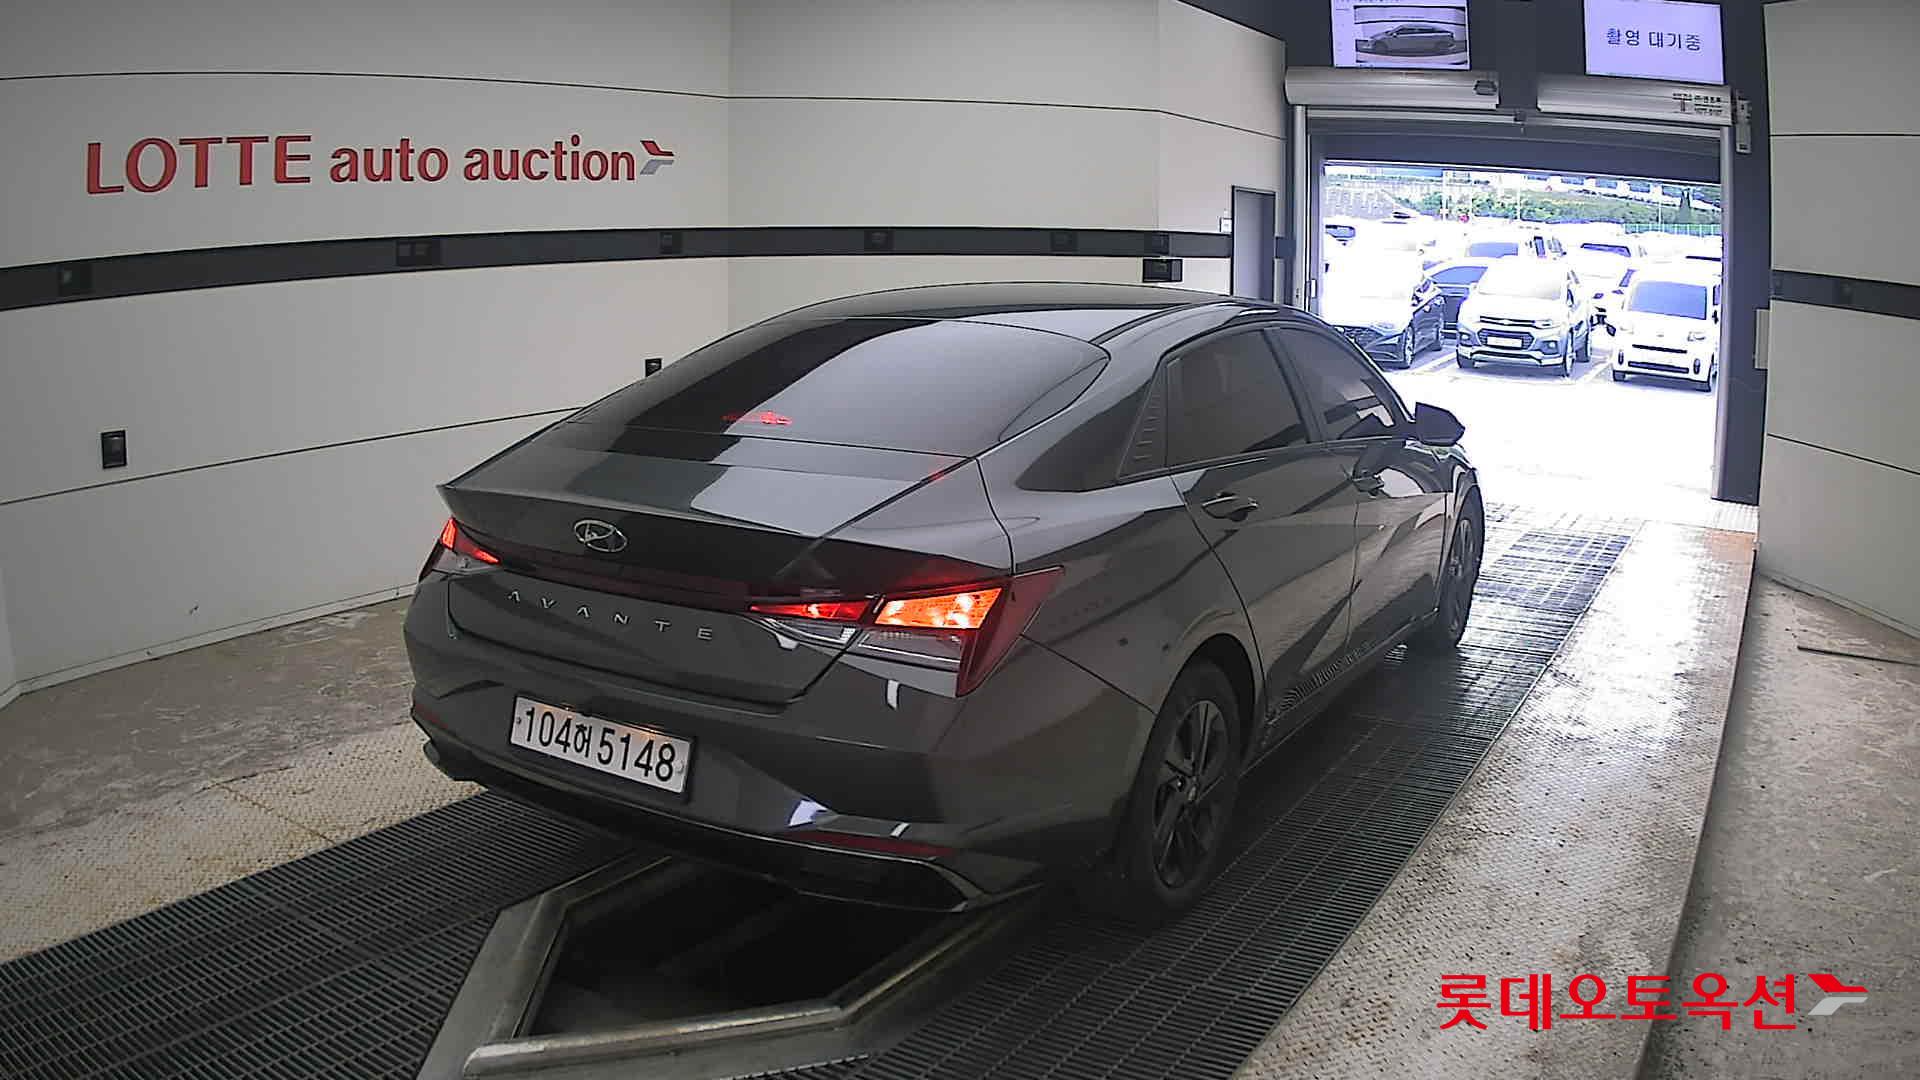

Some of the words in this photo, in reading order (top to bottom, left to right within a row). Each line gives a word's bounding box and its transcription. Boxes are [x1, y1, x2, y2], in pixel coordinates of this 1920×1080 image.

[1607, 28, 1640, 47] 촬영
[1648, 31, 1701, 51] 대기중
[86, 134, 312, 195] LOTTE
[329, 138, 449, 183] auto
[463, 134, 636, 182] auction
[508, 590, 713, 641] AVANTE
[525, 706, 593, 758] 104허
[596, 727, 676, 782] 5148
